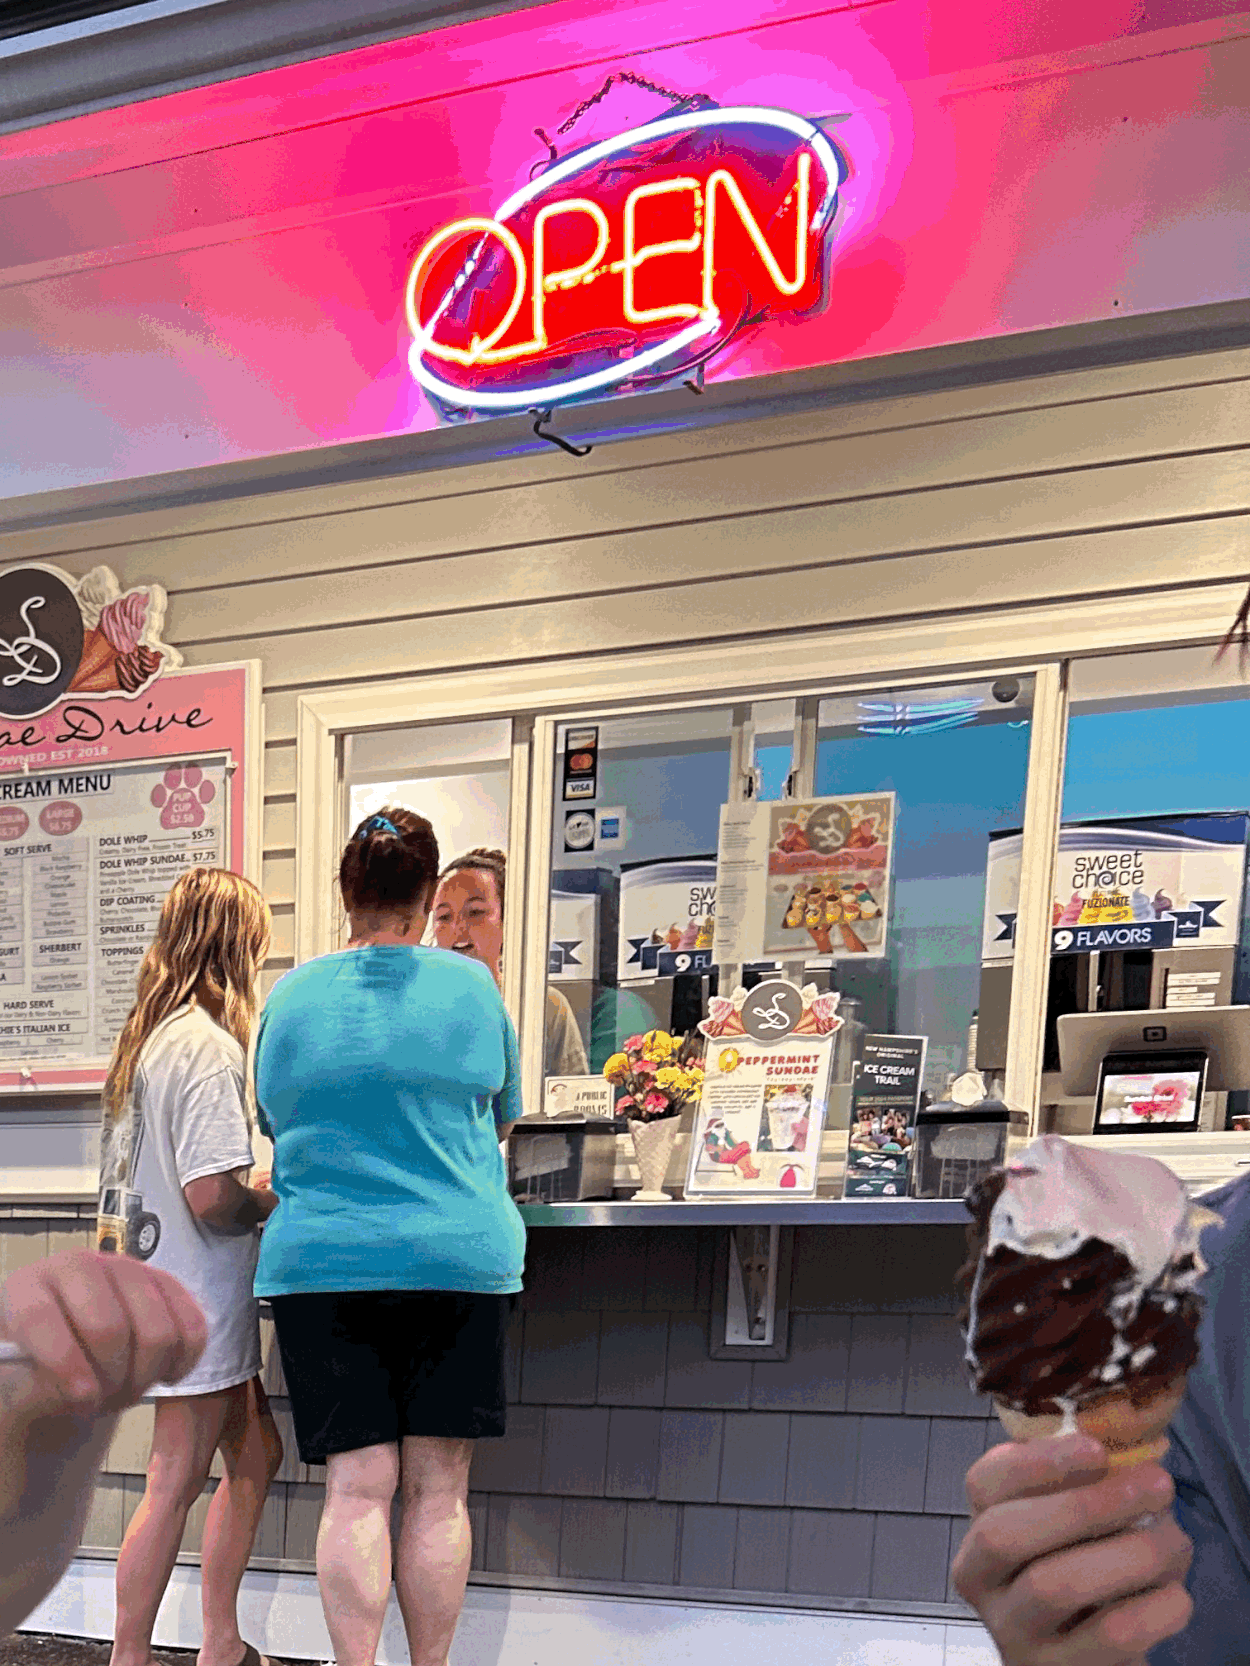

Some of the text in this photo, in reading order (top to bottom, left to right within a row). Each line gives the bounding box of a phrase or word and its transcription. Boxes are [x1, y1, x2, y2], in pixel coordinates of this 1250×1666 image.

[406, 153, 810, 365] OPEN
[56, 702, 213, 743] Drive
[51, 749, 73, 760] EST
[78, 746, 109, 757] 2018
[59, 774, 111, 795] MENU
[571, 783, 591, 793] VISA
[99, 828, 215, 847] DOLE WHIP $5.75
[4, 844, 52, 857] SOFT SERVE
[99, 851, 216, 869] DOLE WHIP SUNDAE $7.75
[1075, 849, 1143, 873] sweet
[100, 895, 155, 907] DIP COATING
[1082, 895, 1130, 909] FUZIONATE
[100, 924, 145, 935] SPRINKLES
[1053, 927, 1152, 950] 9 FLAVORS
[39, 943, 82, 953] SHERBERT
[101, 946, 144, 957] TOPPINGS
[675, 954, 692, 972] 9
[3, 999, 54, 1010] HARD SERVE
[23, 1024, 56, 1033] ITALIAN
[58, 1023, 71, 1032] ICE
[737, 1054, 820, 1066] PEPPERMINT
[766, 1066, 819, 1076] SUNDAE
[864, 1064, 915, 1076] ICE CREAM
[875, 1075, 901, 1086] TRAIL
